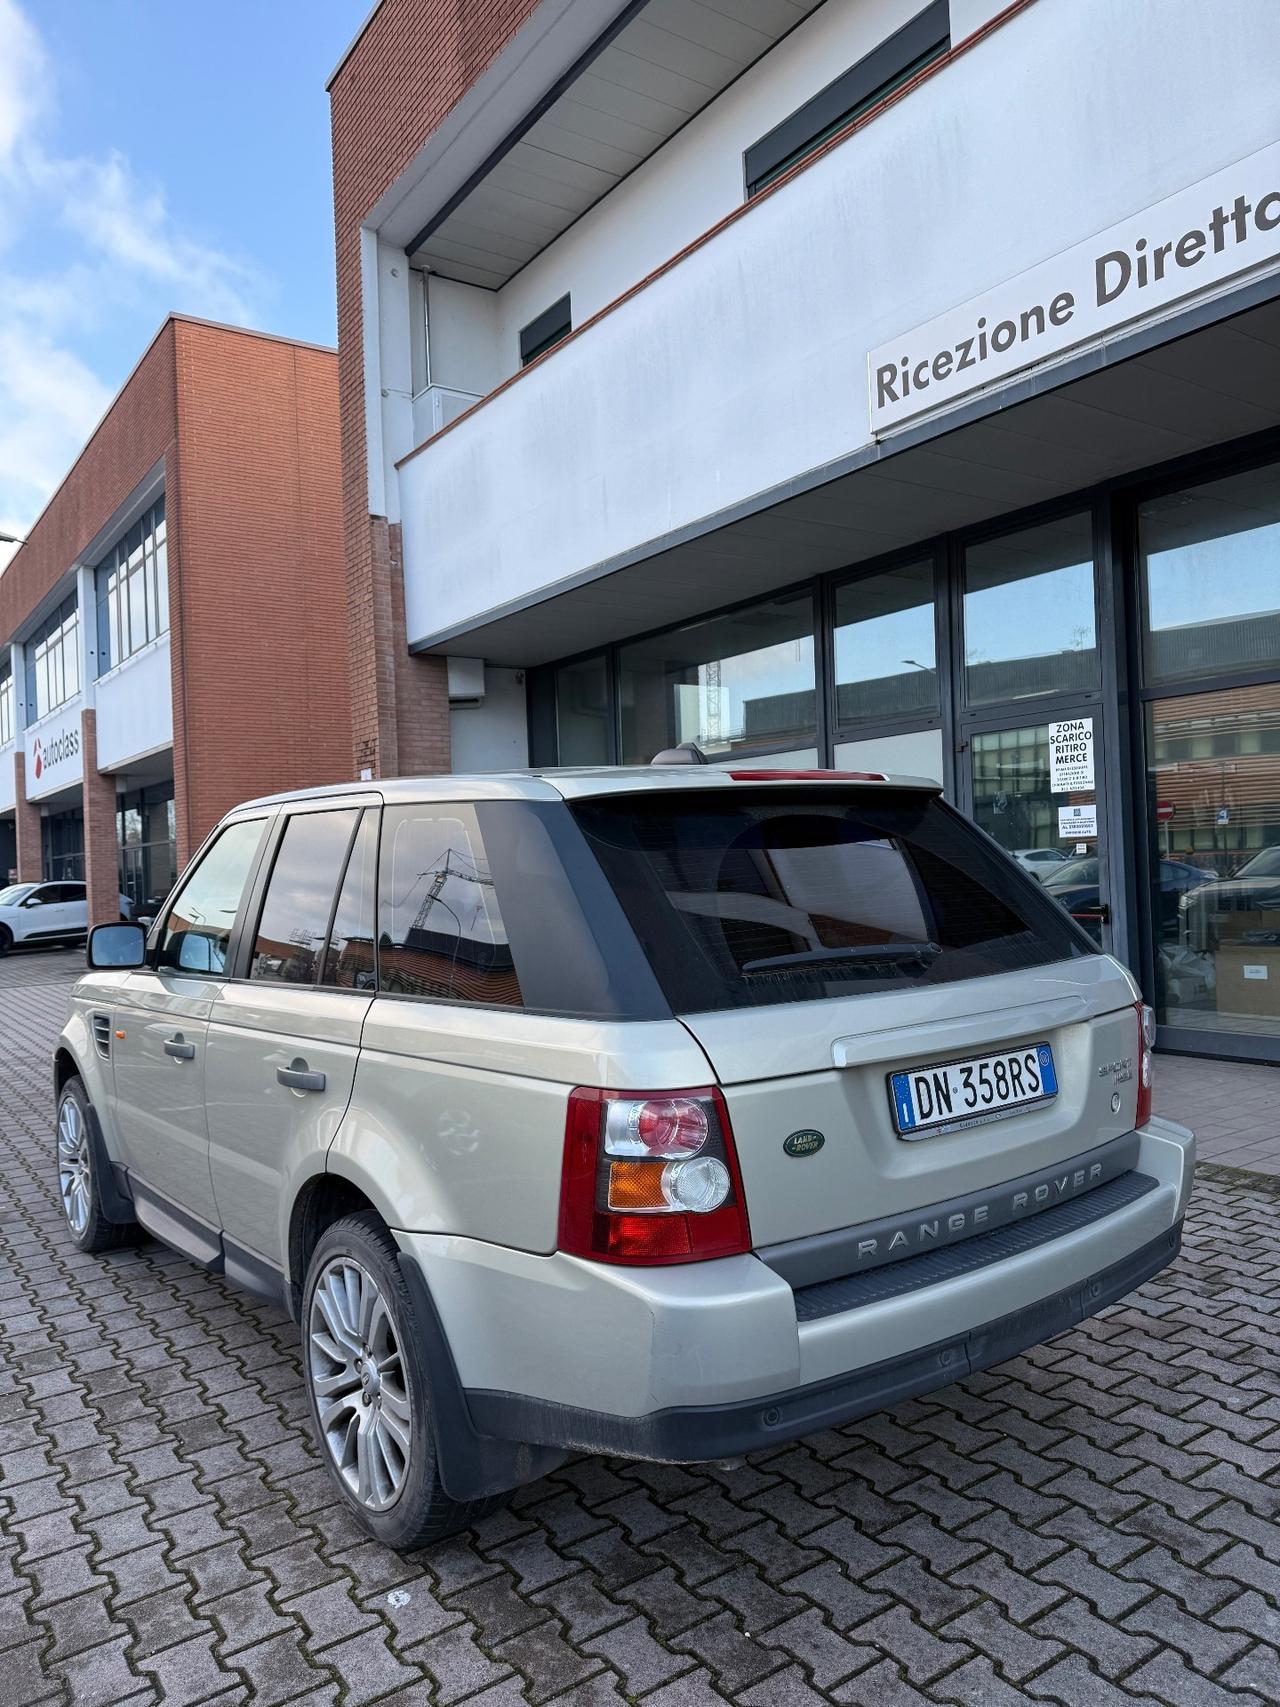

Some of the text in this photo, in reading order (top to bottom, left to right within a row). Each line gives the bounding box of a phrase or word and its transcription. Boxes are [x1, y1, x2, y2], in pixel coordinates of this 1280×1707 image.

[876, 293, 1075, 409] Ricezione
[1056, 721, 1085, 733] ZONA
[1050, 731, 1092, 745] SCARICO
[43, 728, 79, 770] autoclass
[1055, 742, 1087, 754] RITIRO
[1055, 753, 1088, 765] MERCE
[914, 1053, 1040, 1120] DN 358RS
[794, 1135, 813, 1144] LAND
[857, 1163, 1102, 1260] RANGE ROVER
